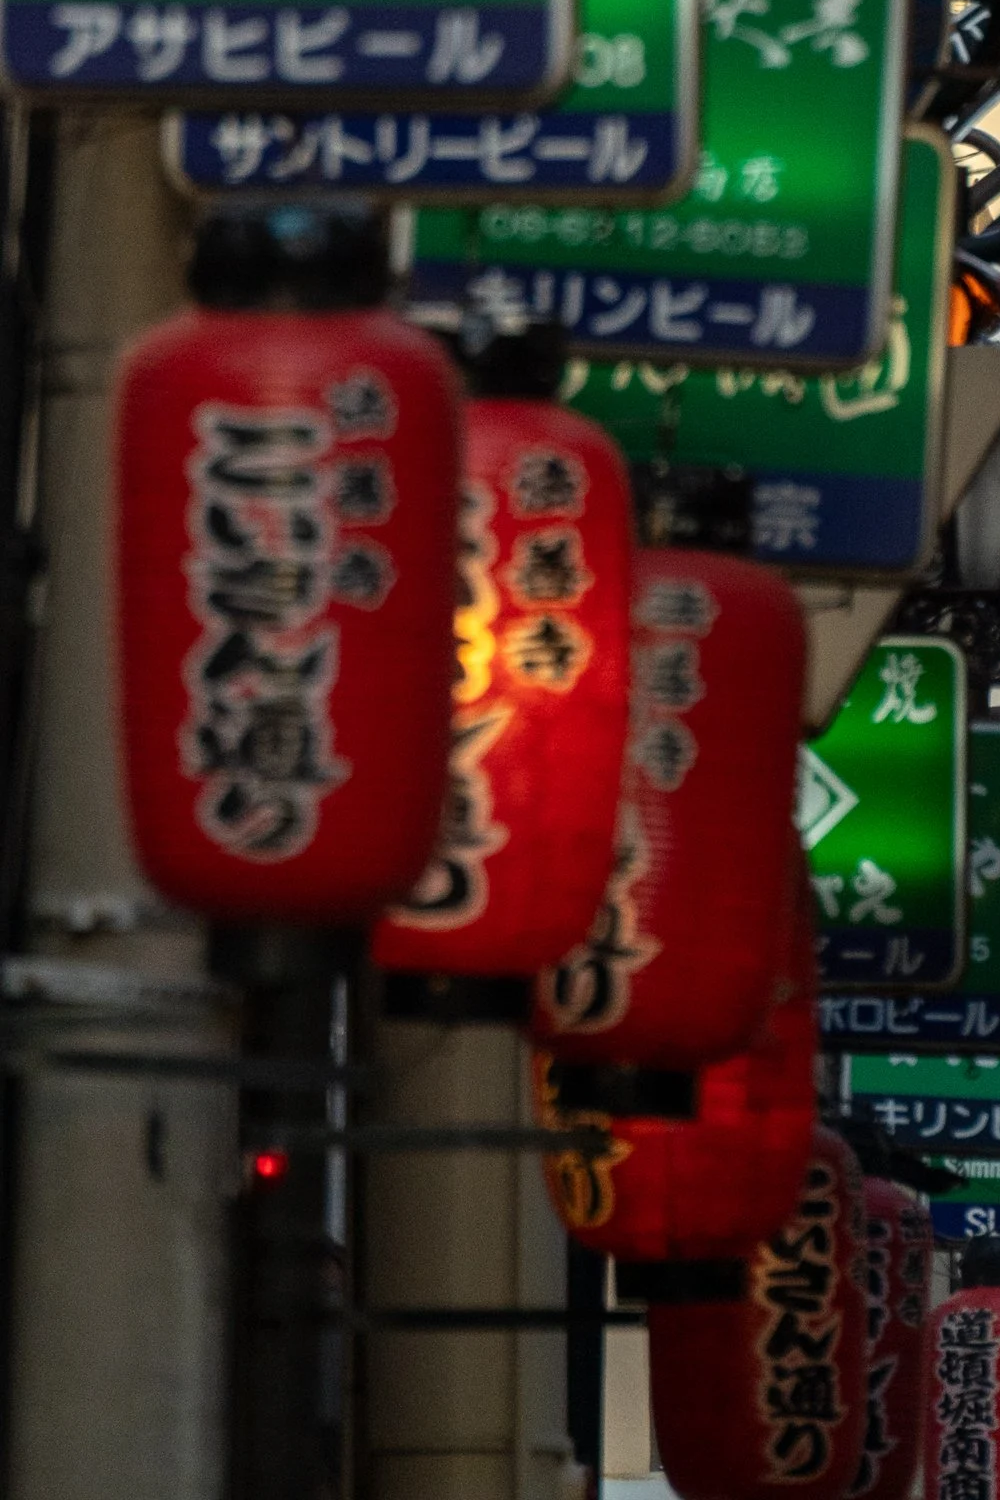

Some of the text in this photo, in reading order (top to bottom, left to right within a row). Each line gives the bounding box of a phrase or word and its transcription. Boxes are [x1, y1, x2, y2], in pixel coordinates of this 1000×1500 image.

[48, 2, 504, 84] アサヒビール
